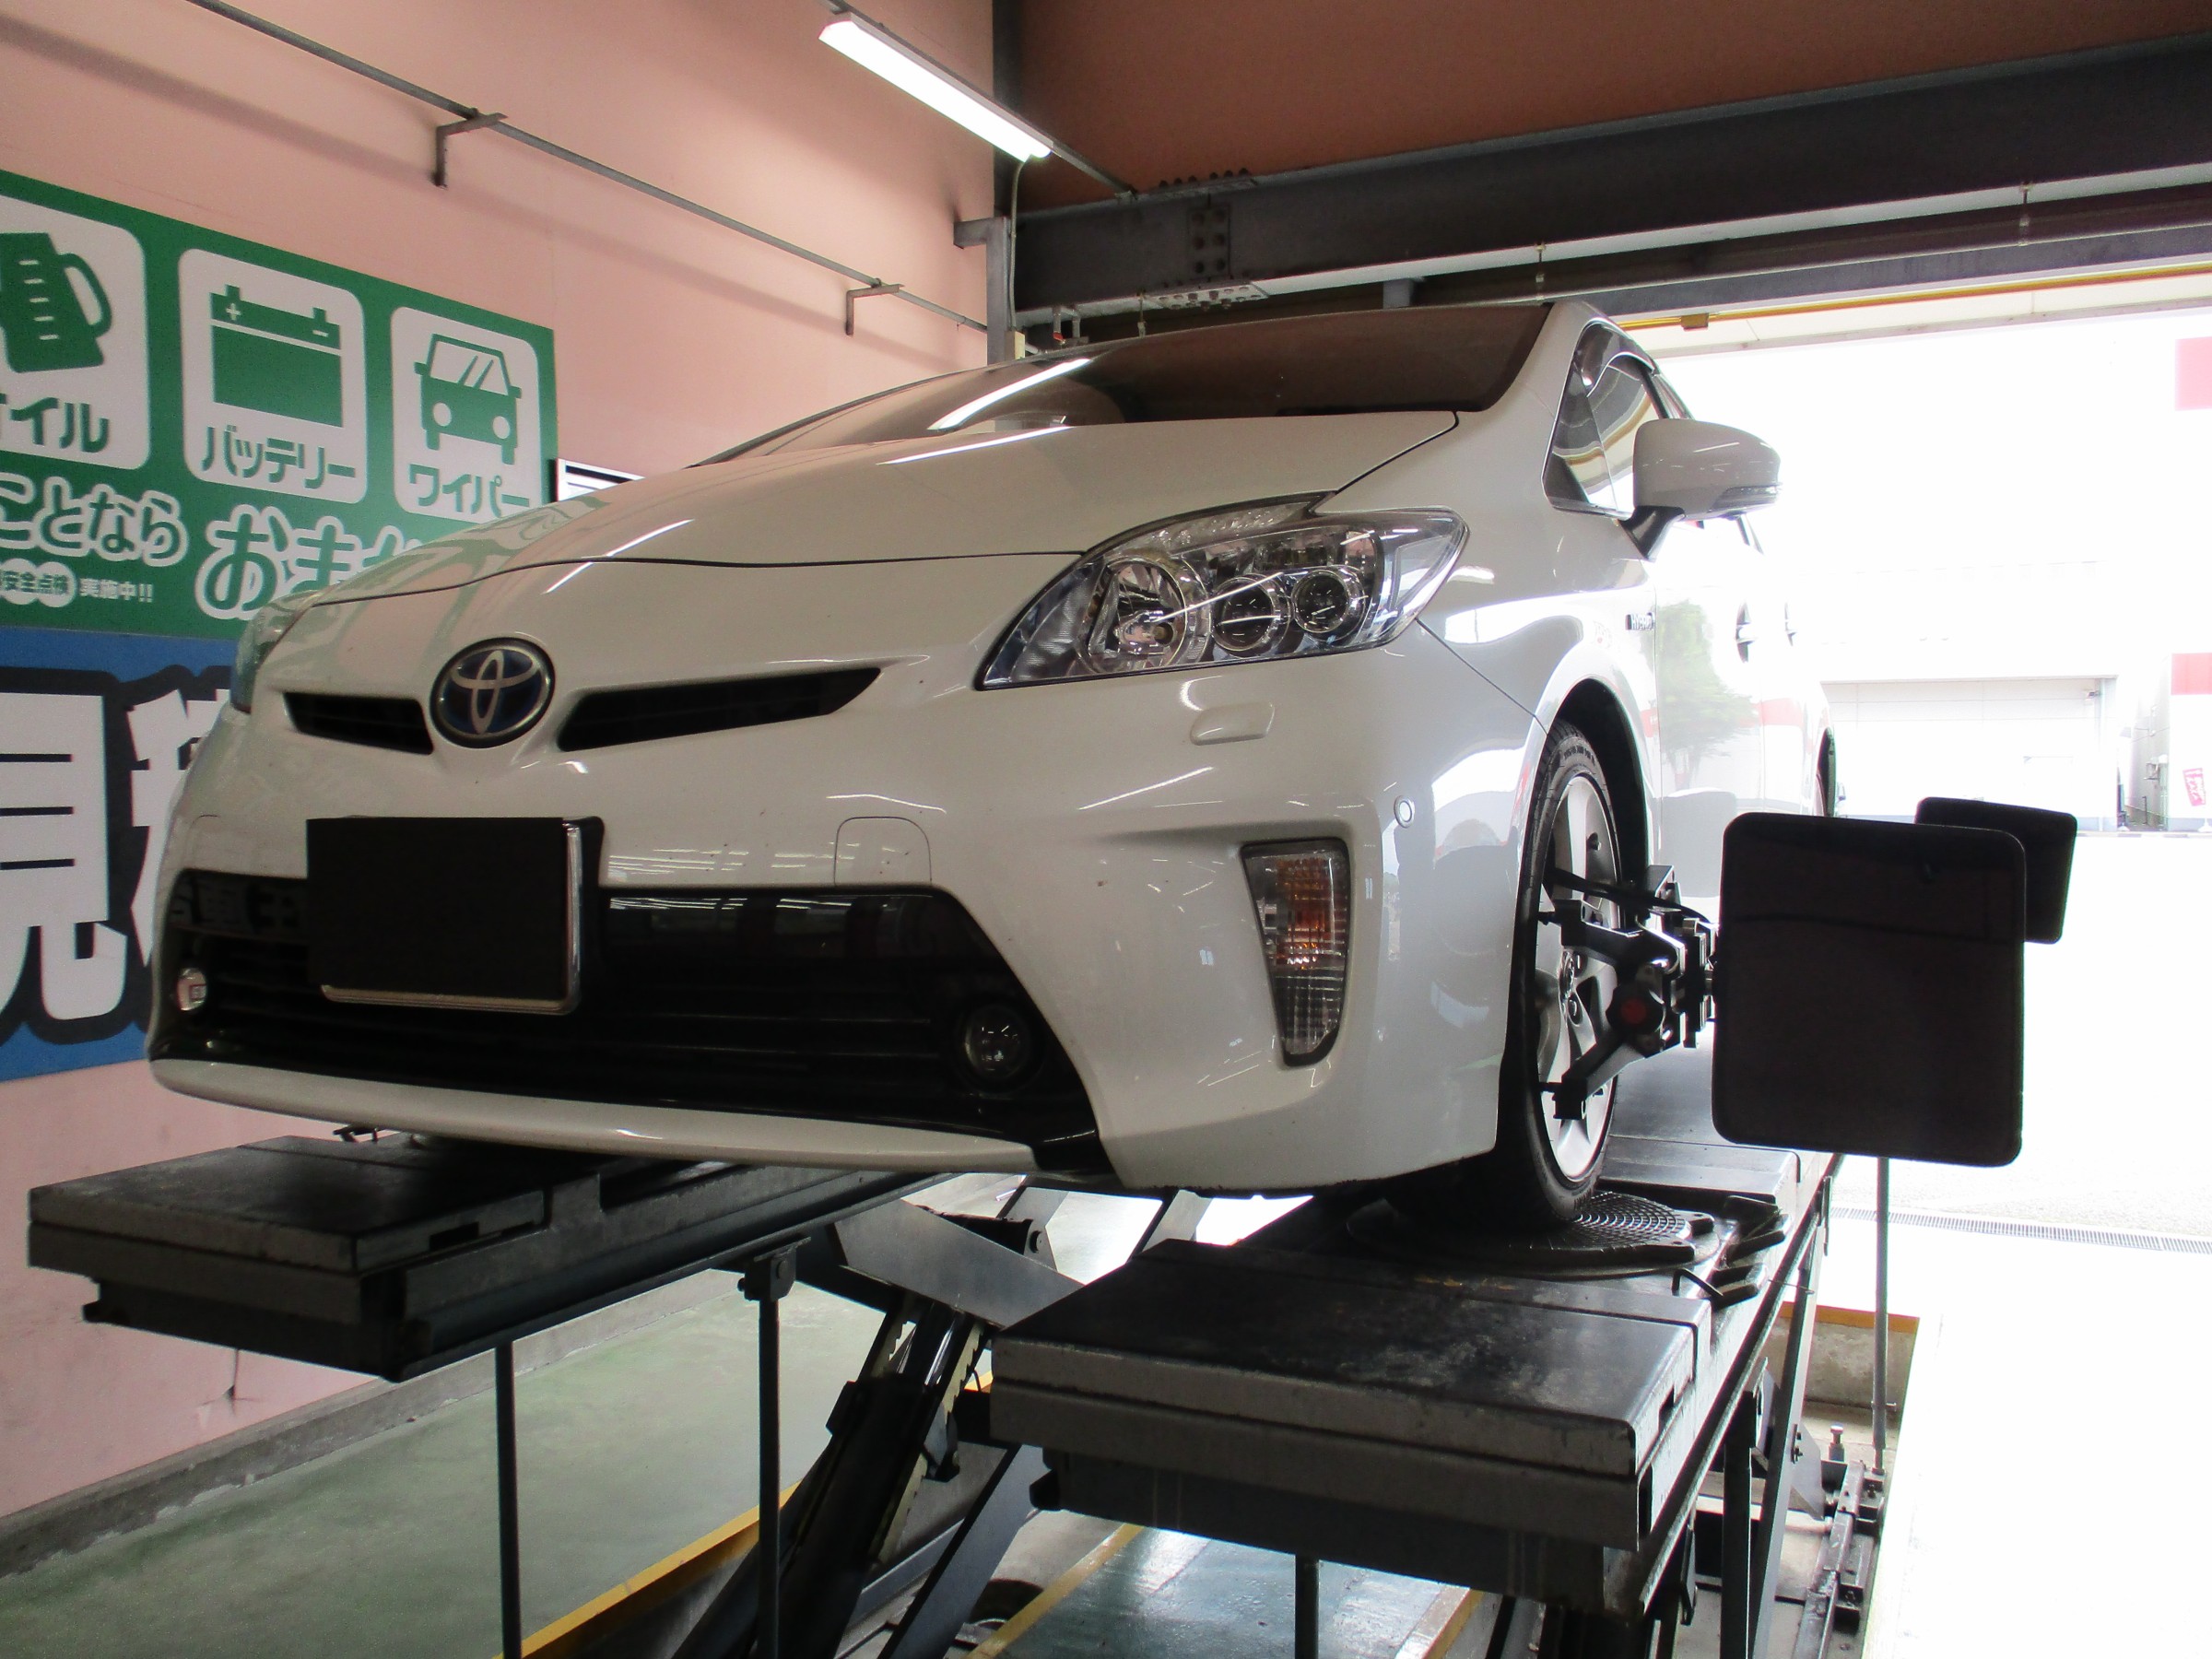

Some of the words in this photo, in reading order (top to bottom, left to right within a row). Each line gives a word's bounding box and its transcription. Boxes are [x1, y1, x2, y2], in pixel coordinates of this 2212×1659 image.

[0, 393, 109, 453] イル
[201, 424, 356, 490] バッテリー
[409, 463, 530, 518] ワイパー
[200, 510, 398, 613] おま
